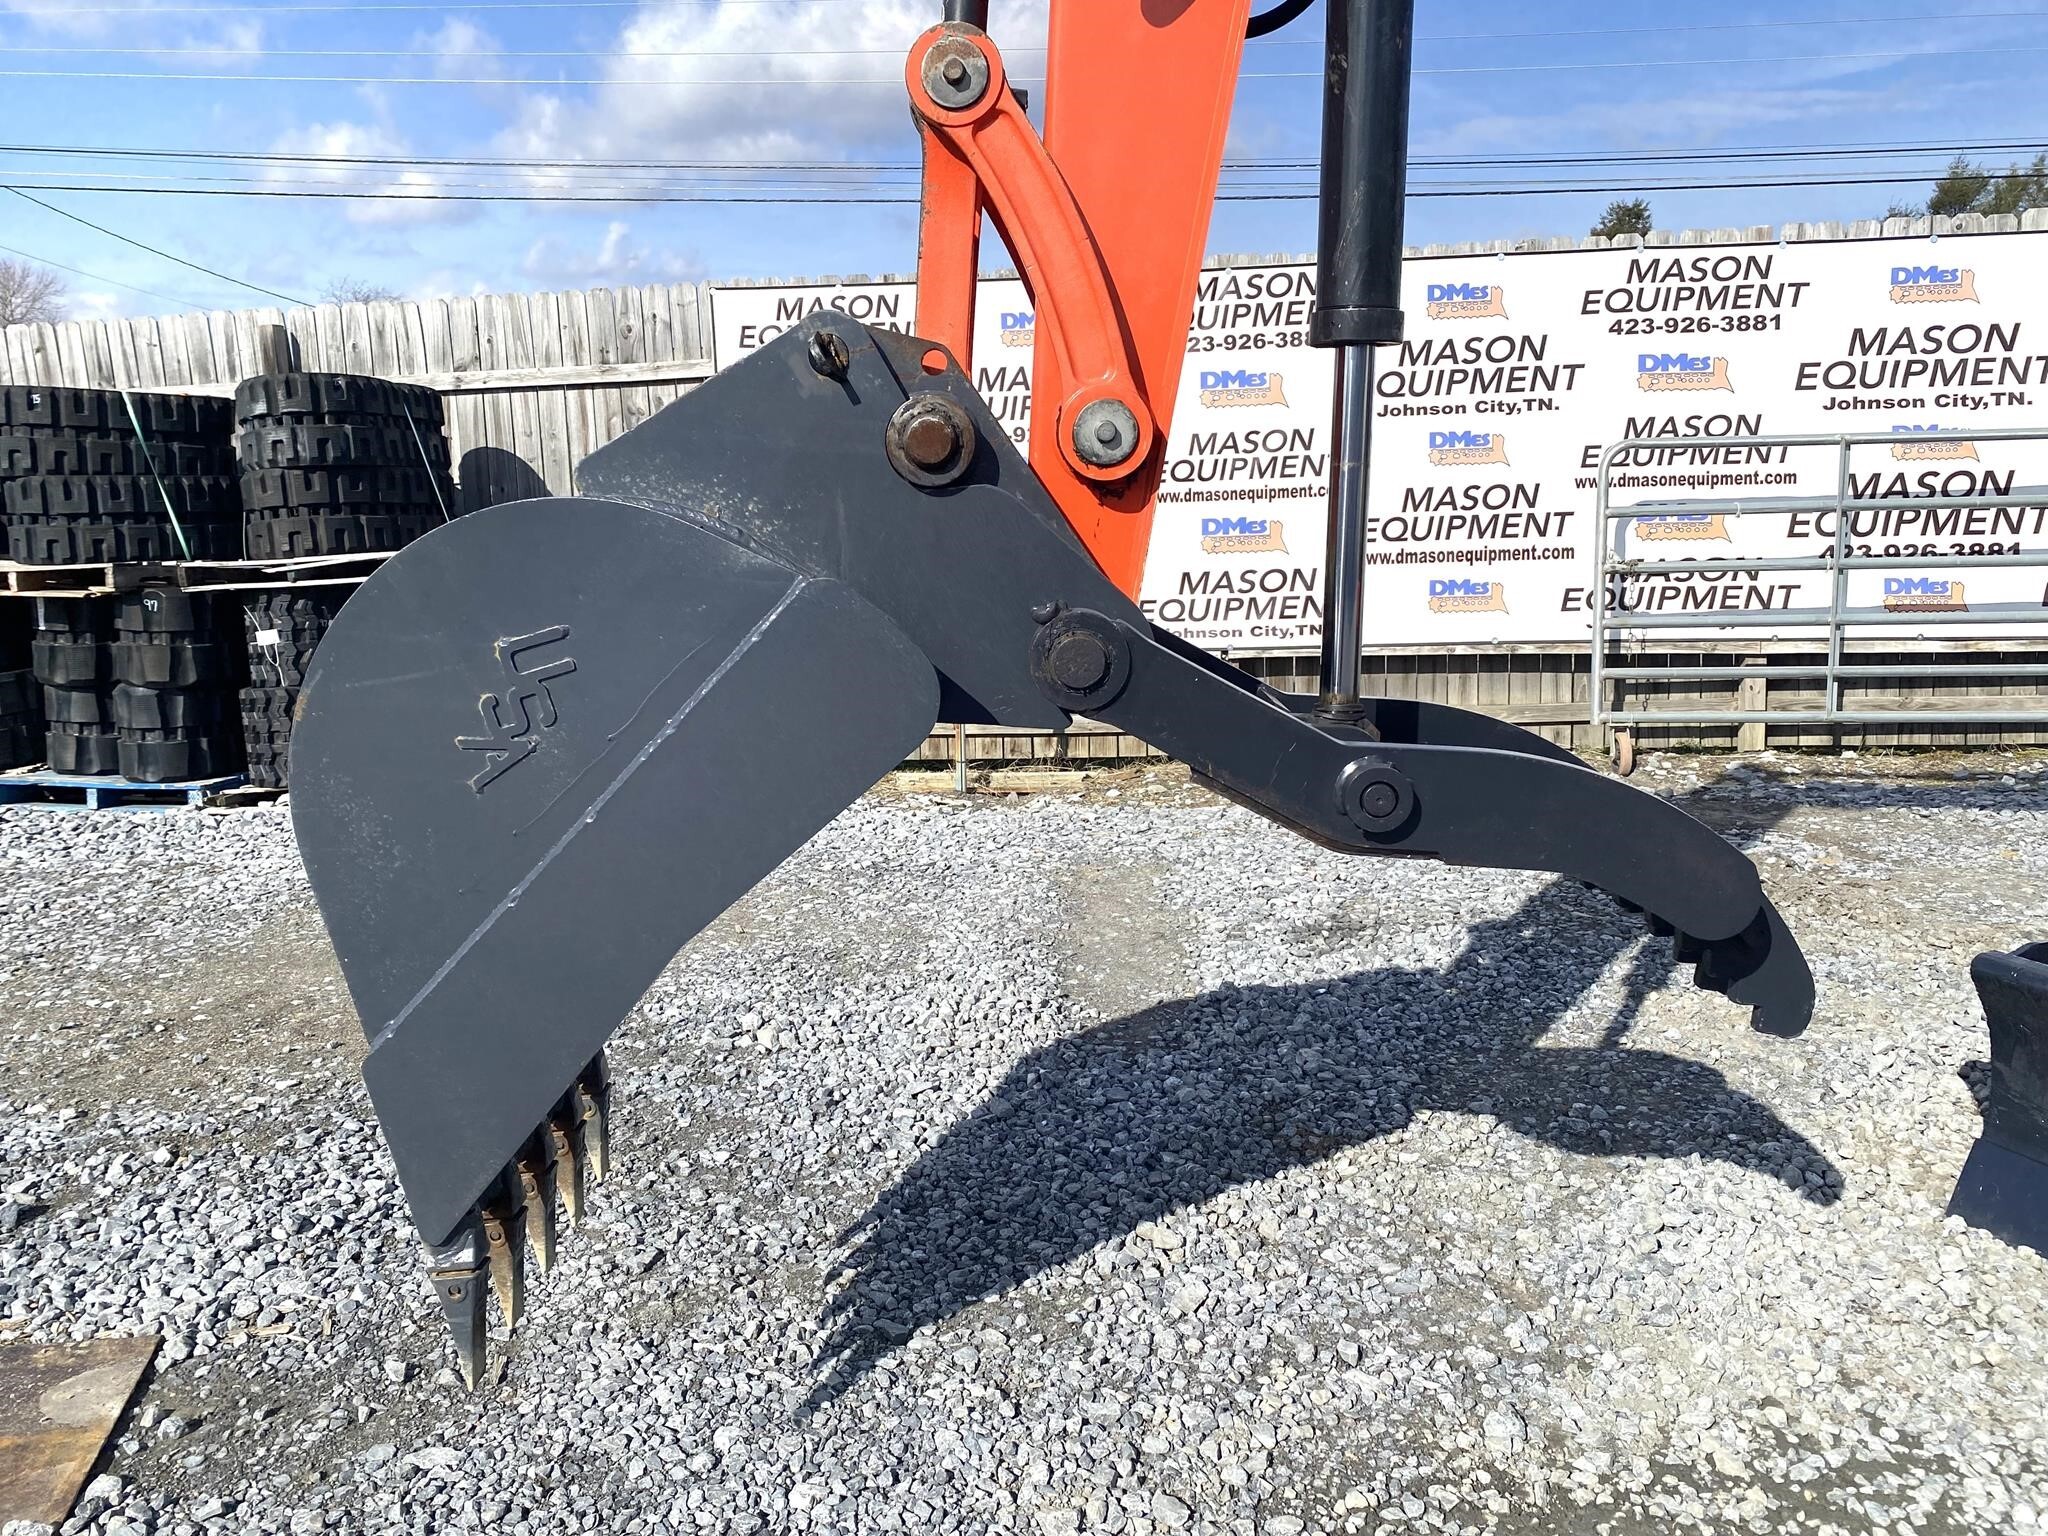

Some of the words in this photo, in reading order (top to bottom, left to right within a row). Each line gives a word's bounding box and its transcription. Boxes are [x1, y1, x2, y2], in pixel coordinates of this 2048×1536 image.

[1626, 255, 1773, 284] MASON
[1196, 271, 1317, 302] MASON
[1580, 282, 1811, 315] EQUIPMENT
[776, 294, 899, 321] MASON
[1000, 312, 1035, 330] DM
[1189, 300, 1317, 331] UIPME
[1608, 314, 1781, 336] 423-926-3881
[1187, 331, 1312, 353] 23-926-38
[1398, 334, 1549, 367] MASON
[1847, 322, 2021, 357] MASON
[1376, 363, 1586, 398] QUIPMENT
[1794, 355, 2048, 391] EQUIPMENT
[1377, 402, 1467, 418] Johnson
[1474, 398, 1561, 416] City,TN.
[1822, 396, 1926, 411] Johnson
[1934, 391, 2033, 411] City,TN.
[1623, 414, 1762, 440] MASON
[1189, 428, 1315, 456] MASON
[1580, 444, 1788, 468] EQUIPMENT
[1161, 453, 1330, 483] QUIPMEN
[1157, 484, 1329, 504] ww.dmasonequipment.c
[1401, 483, 1541, 513] MASON
[1848, 469, 2015, 500] MASON
[1786, 507, 2048, 538] EQUIPMENT
[1366, 544, 1575, 566] ww.dmasonequipment.com
[1178, 568, 1318, 595] MASON
[143, 599, 158, 612] 97
[1139, 595, 1323, 623] EQUIPMEN
[1560, 584, 1801, 612] EQUIPMENT
[1250, 624, 1322, 640] City,TN
[454, 624, 578, 795] USA
